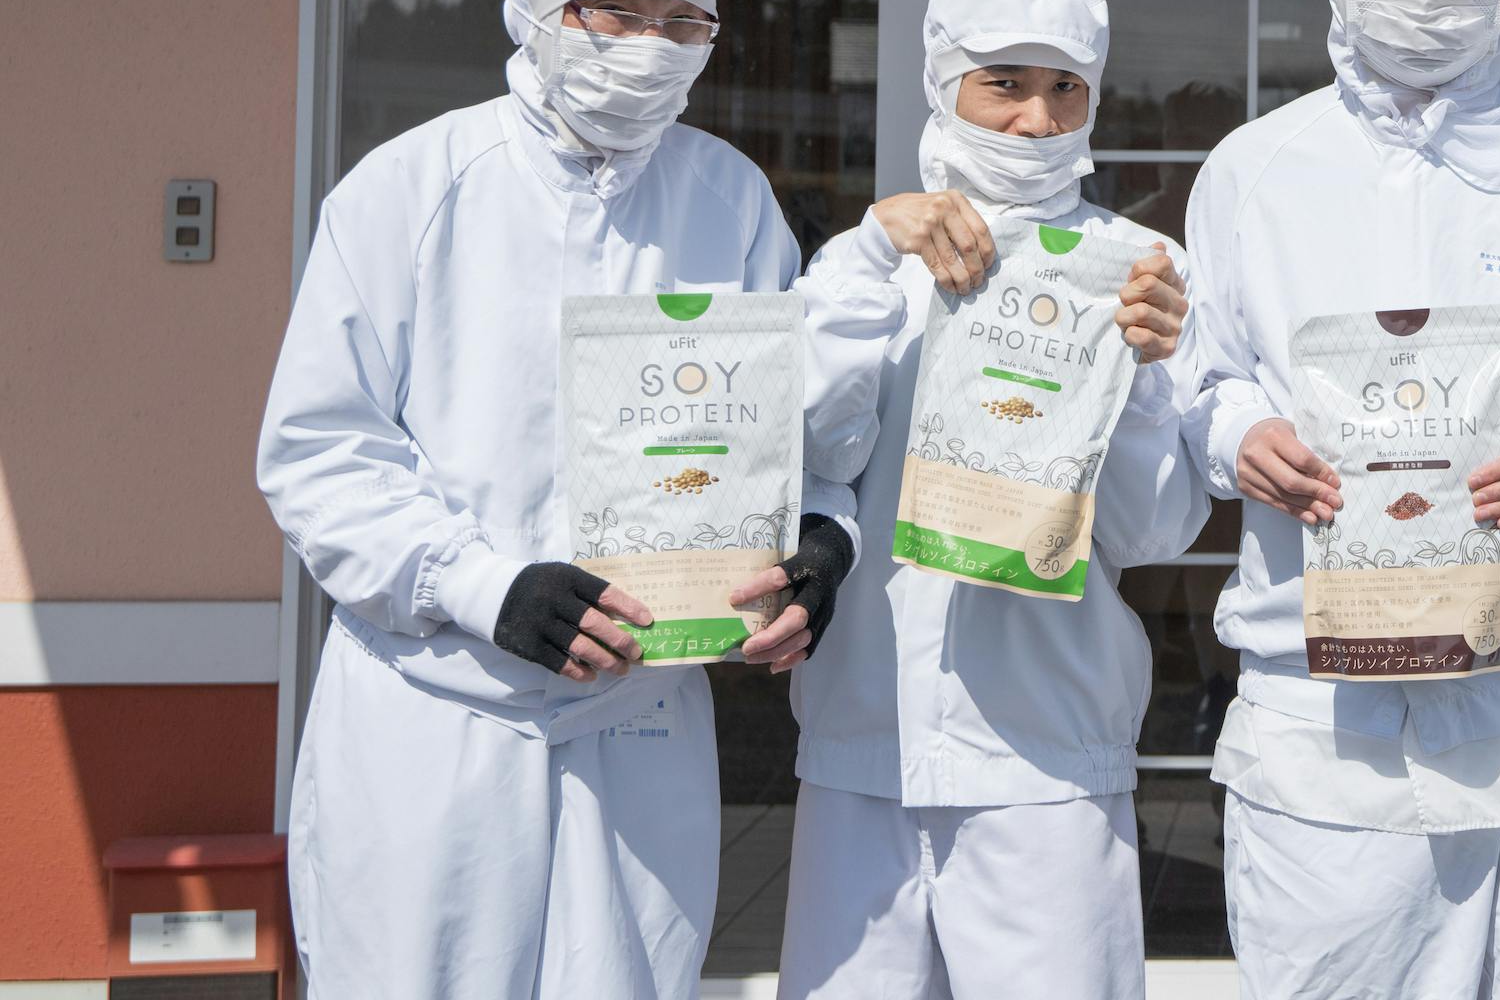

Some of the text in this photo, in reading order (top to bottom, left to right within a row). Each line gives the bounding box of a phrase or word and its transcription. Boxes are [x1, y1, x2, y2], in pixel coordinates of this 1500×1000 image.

[1034, 269, 1060, 282] uFit
[998, 286, 1094, 333] SOY
[669, 337, 697, 350] uFit
[969, 321, 1096, 367] PROTEIN
[1390, 353, 1416, 366] uFit
[998, 360, 1054, 378] Made in Japan
[641, 361, 742, 397] SOY
[1362, 376, 1459, 412] SOY
[620, 404, 757, 426] PROTEIN
[1342, 416, 1476, 442] PROTEIN
[642, 638, 736, 654] ソイプロテイ
[1320, 643, 1410, 654] 余計なものは入れない、
[1321, 654, 1464, 670] シンプルソイプロテイン
